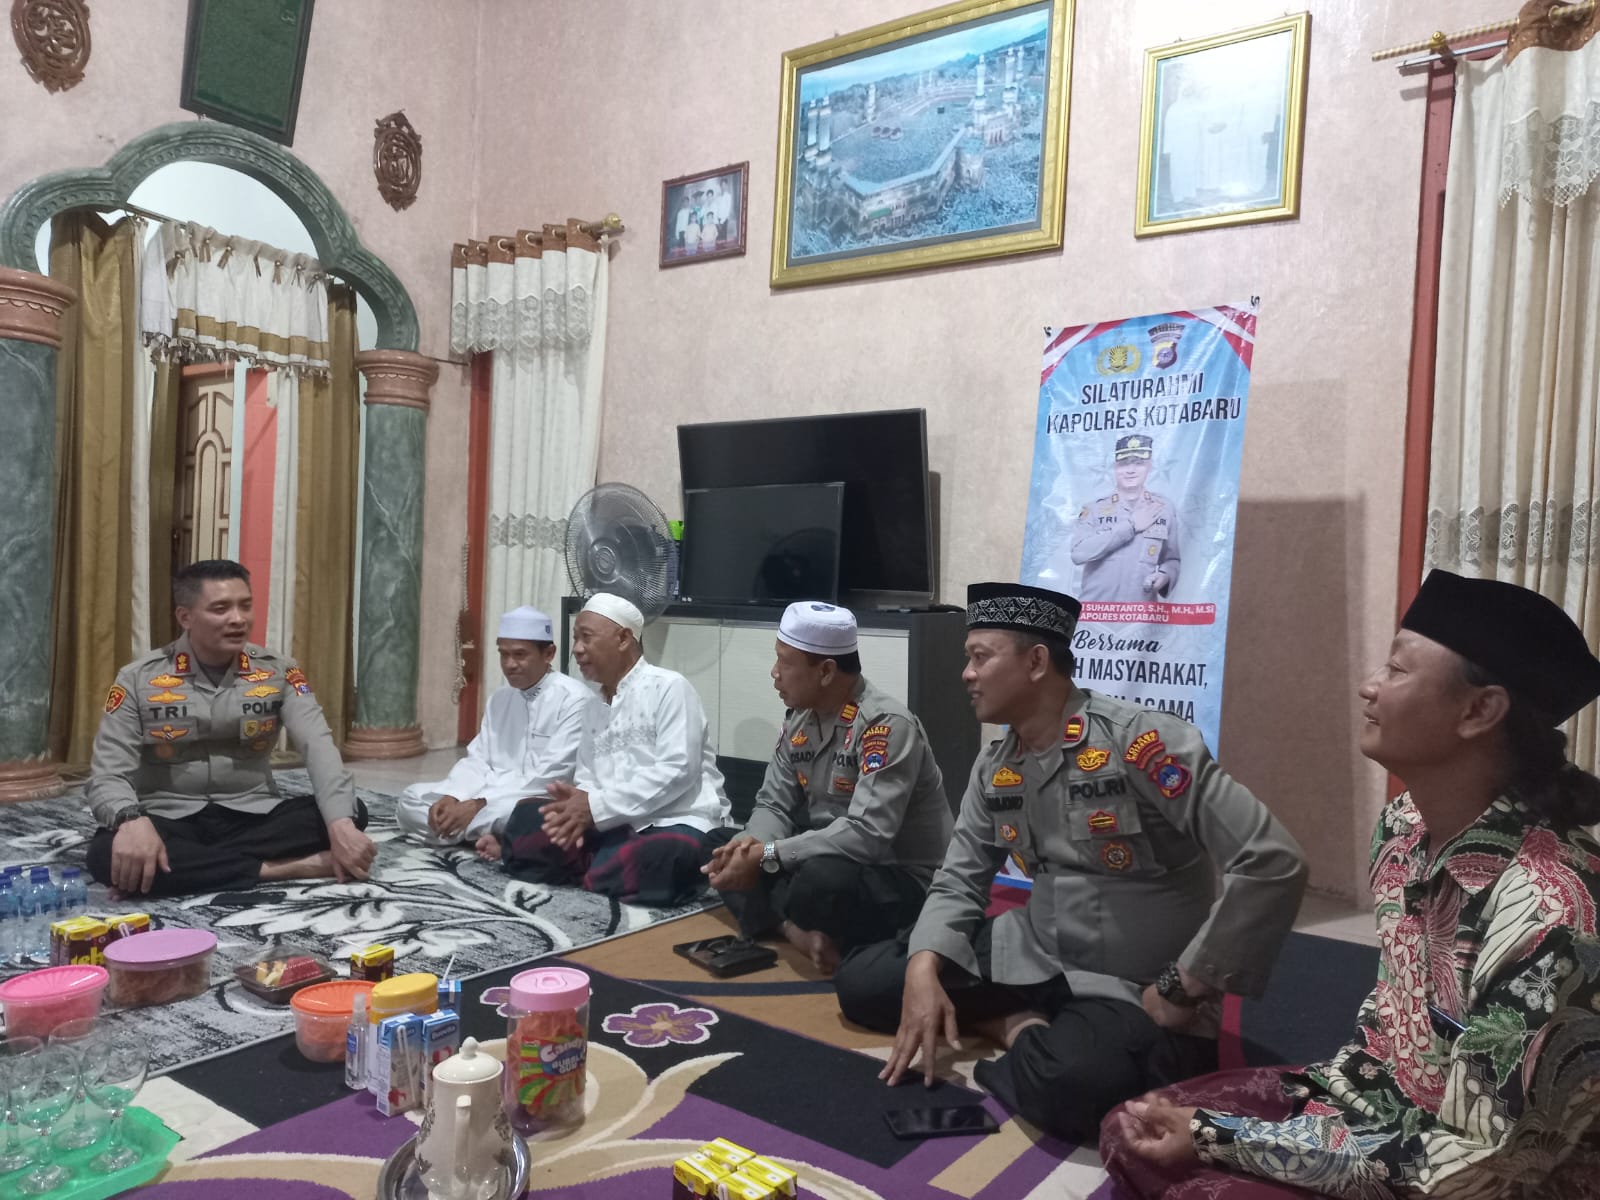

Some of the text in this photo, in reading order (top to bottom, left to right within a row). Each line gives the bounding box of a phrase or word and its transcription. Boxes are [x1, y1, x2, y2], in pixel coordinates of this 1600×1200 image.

[1046, 397, 1241, 434] KAPOLRES KOTABARU
[1098, 516, 1118, 525] TRI
[1081, 612, 1169, 623] APOLRES KOTABARU
[1072, 629, 1163, 653] Bersama
[1088, 657, 1208, 690] MASYARAKAT,
[149, 706, 188, 720] TRI
[1069, 780, 1127, 800] POLRI
